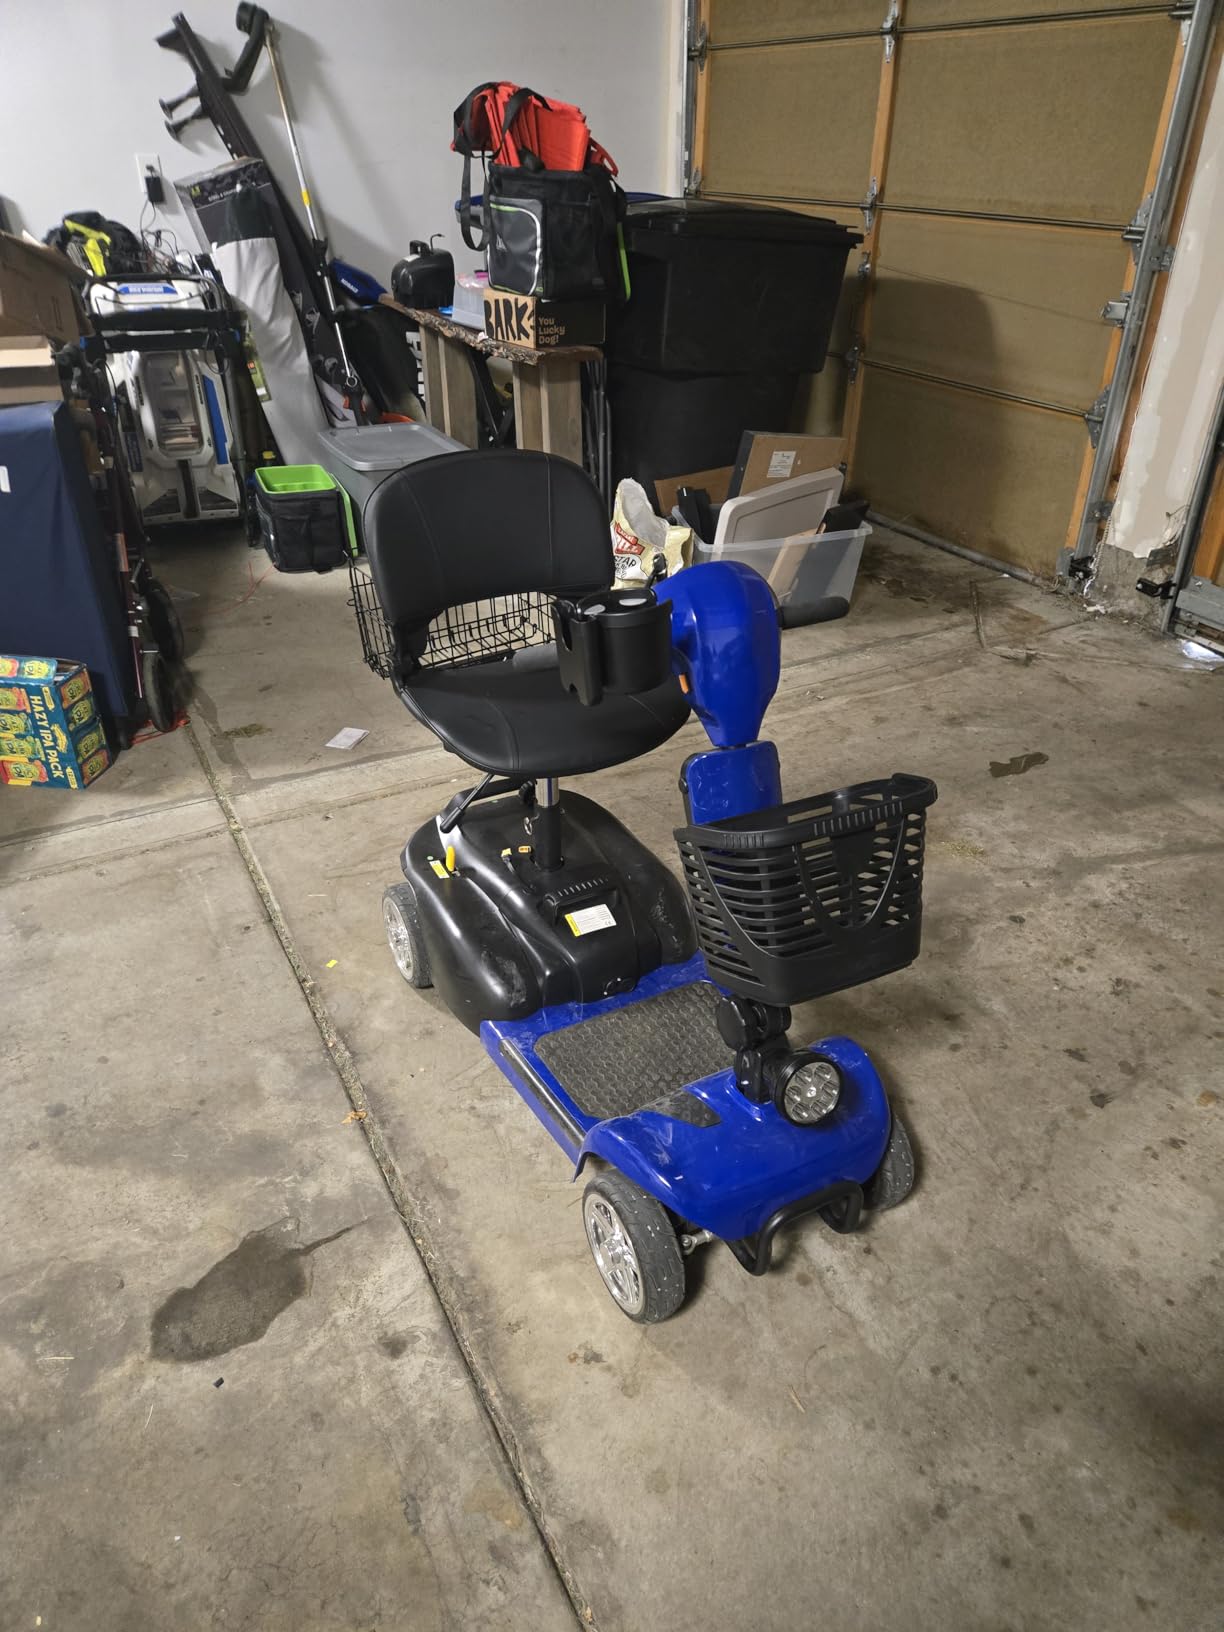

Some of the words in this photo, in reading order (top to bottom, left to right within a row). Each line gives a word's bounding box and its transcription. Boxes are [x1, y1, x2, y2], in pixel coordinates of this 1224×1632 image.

[483, 297, 530, 341] BARK
[539, 317, 555, 326] You
[539, 325, 566, 336] Lucky
[539, 335, 559, 345] Dog!
[30, 695, 50, 728] HAZY
[39, 729, 55, 748] IPA
[46, 749, 65, 779] PACK
